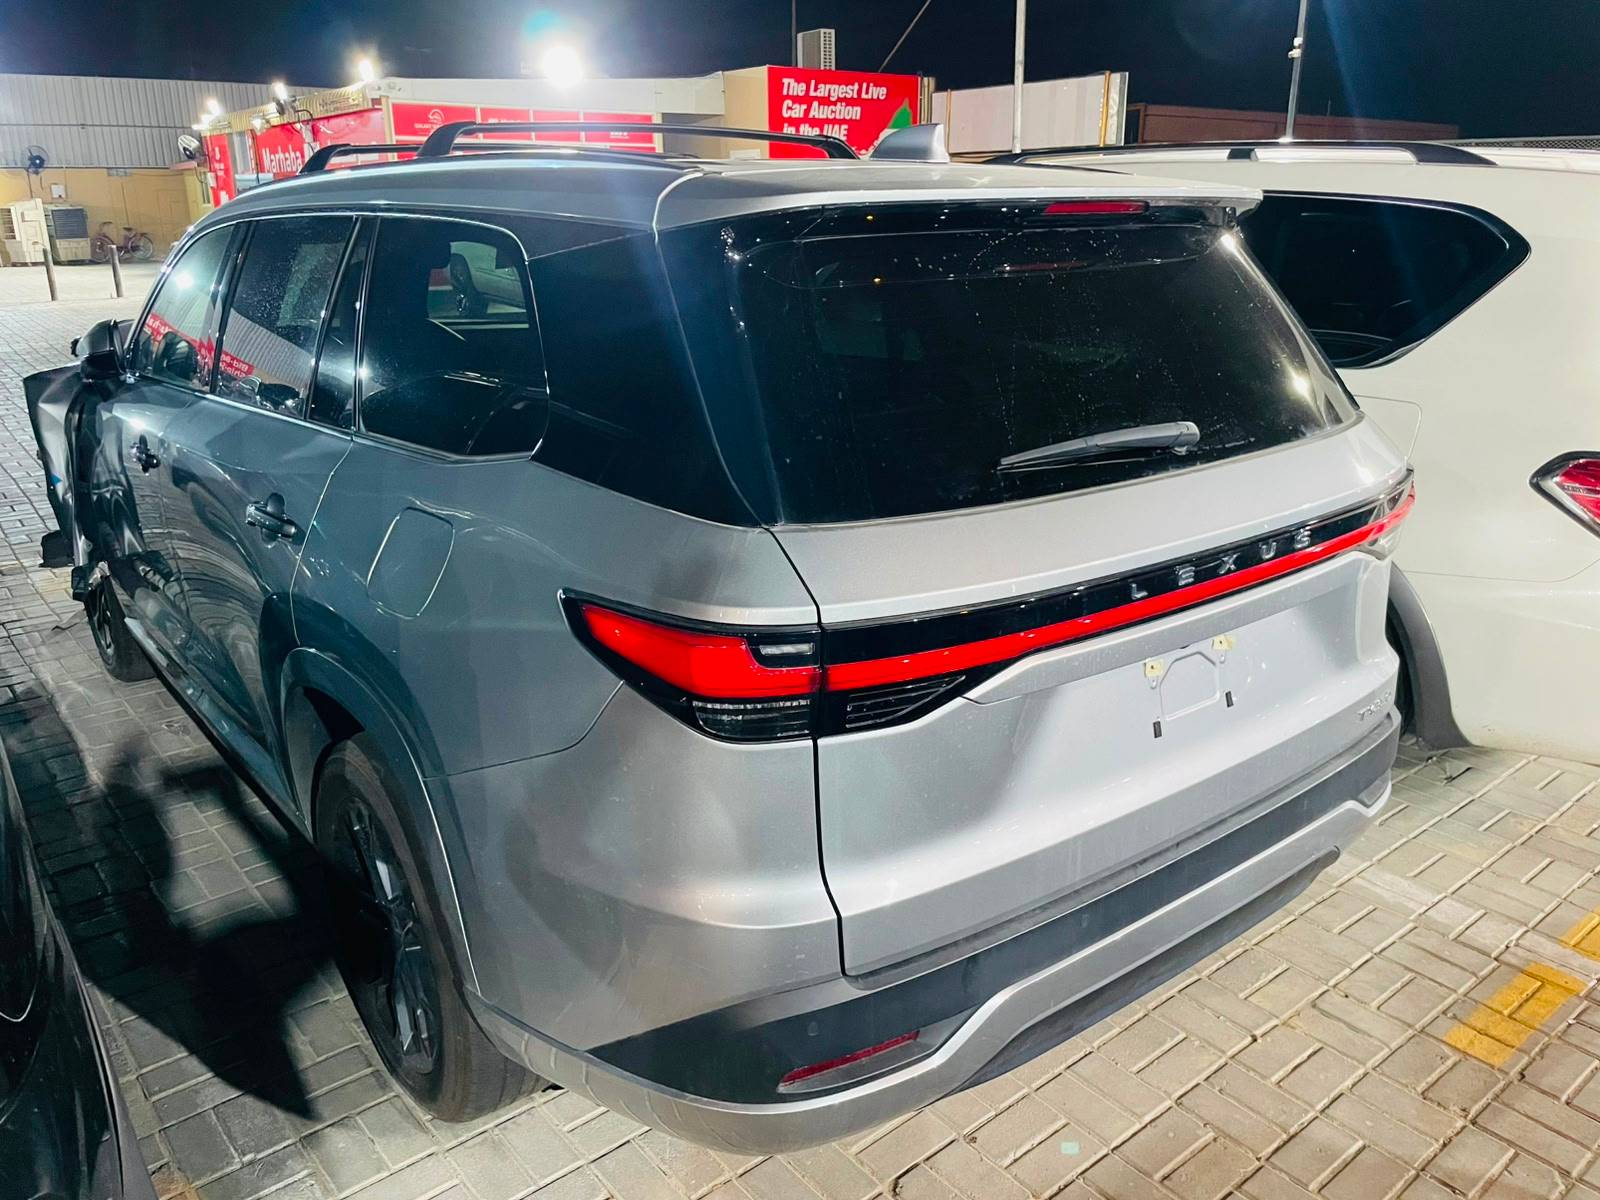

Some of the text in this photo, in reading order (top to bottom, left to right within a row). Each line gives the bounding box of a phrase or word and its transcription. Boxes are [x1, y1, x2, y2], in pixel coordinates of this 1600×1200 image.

[782, 78, 887, 101] The Largest Live
[782, 100, 861, 120] Car Auction
[799, 123, 820, 136] the
[823, 124, 848, 141] UAE
[262, 144, 302, 174] Marhaba
[1130, 526, 1312, 600] LEXUS
